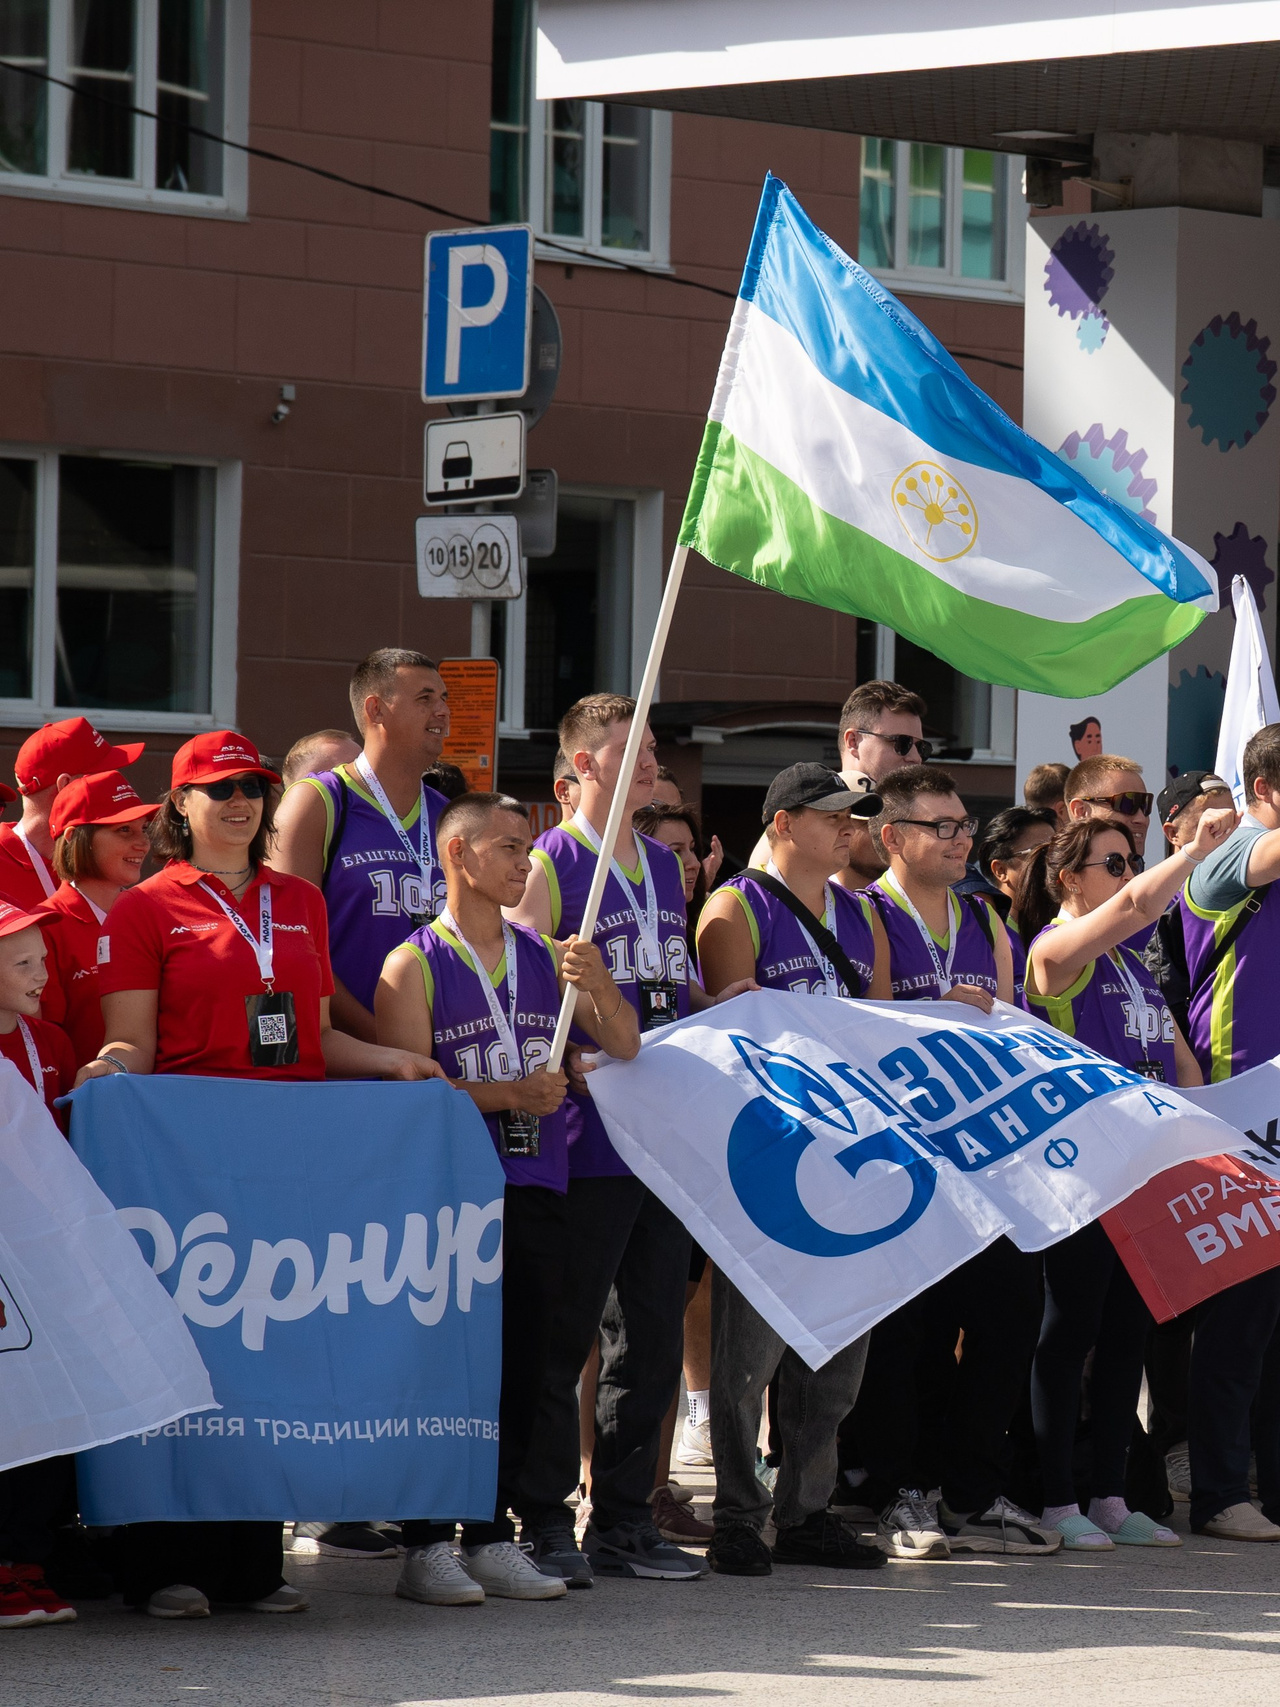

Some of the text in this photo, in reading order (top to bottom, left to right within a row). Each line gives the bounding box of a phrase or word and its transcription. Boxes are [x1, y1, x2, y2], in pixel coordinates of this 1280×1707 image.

[444, 244, 509, 384] P
[428, 541, 502, 570] 10 15 20
[605, 934, 688, 985] 102
[1120, 1000, 1175, 1043] 102
[455, 1036, 555, 1083] 102
[254, 1415, 410, 1446] традиции
[416, 1412, 501, 1442] качества
